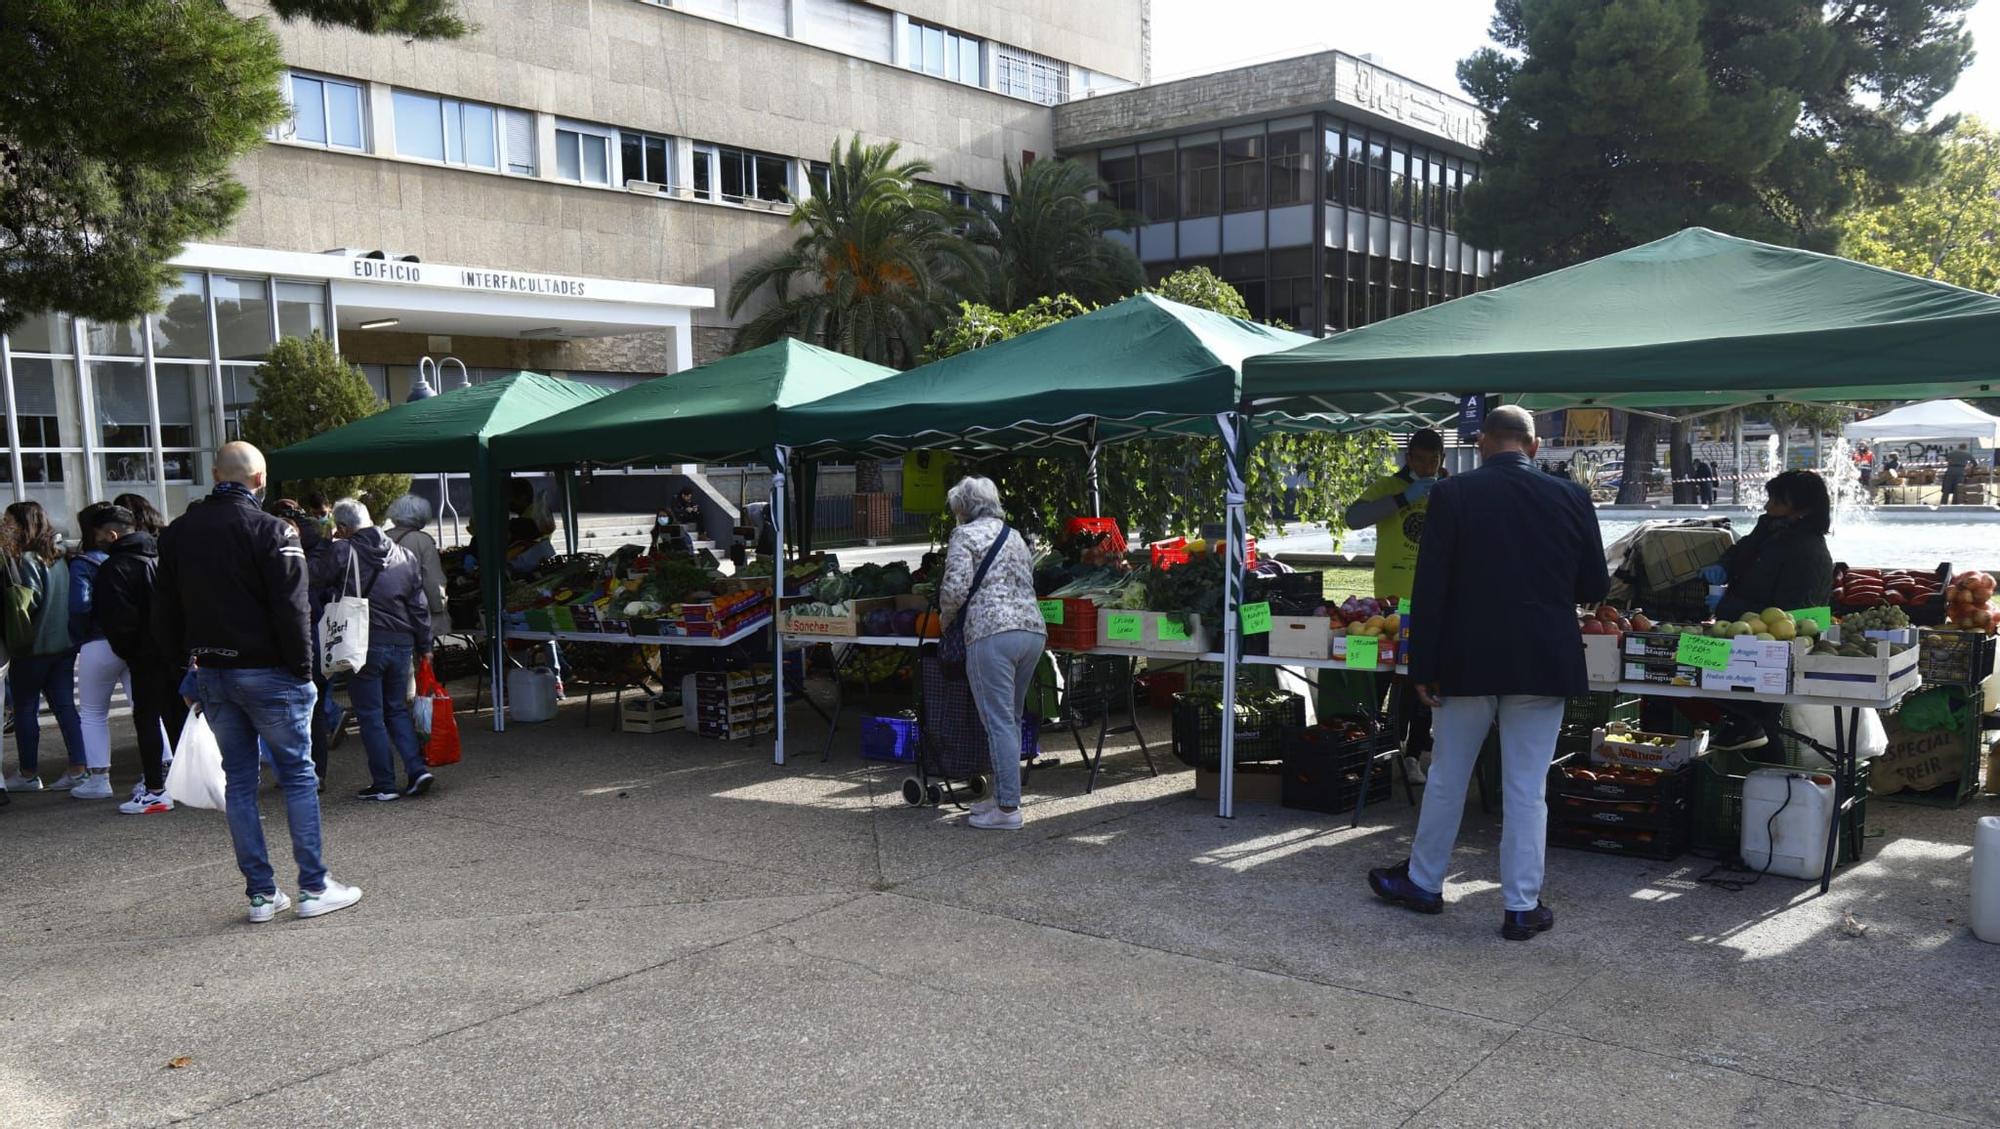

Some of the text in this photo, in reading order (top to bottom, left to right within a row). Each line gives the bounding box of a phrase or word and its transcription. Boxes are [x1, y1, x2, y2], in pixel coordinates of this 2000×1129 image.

[353, 260, 585, 296] EDIFICIO INTERFACULTADES
[1881, 733, 1951, 764] SPECIAL
